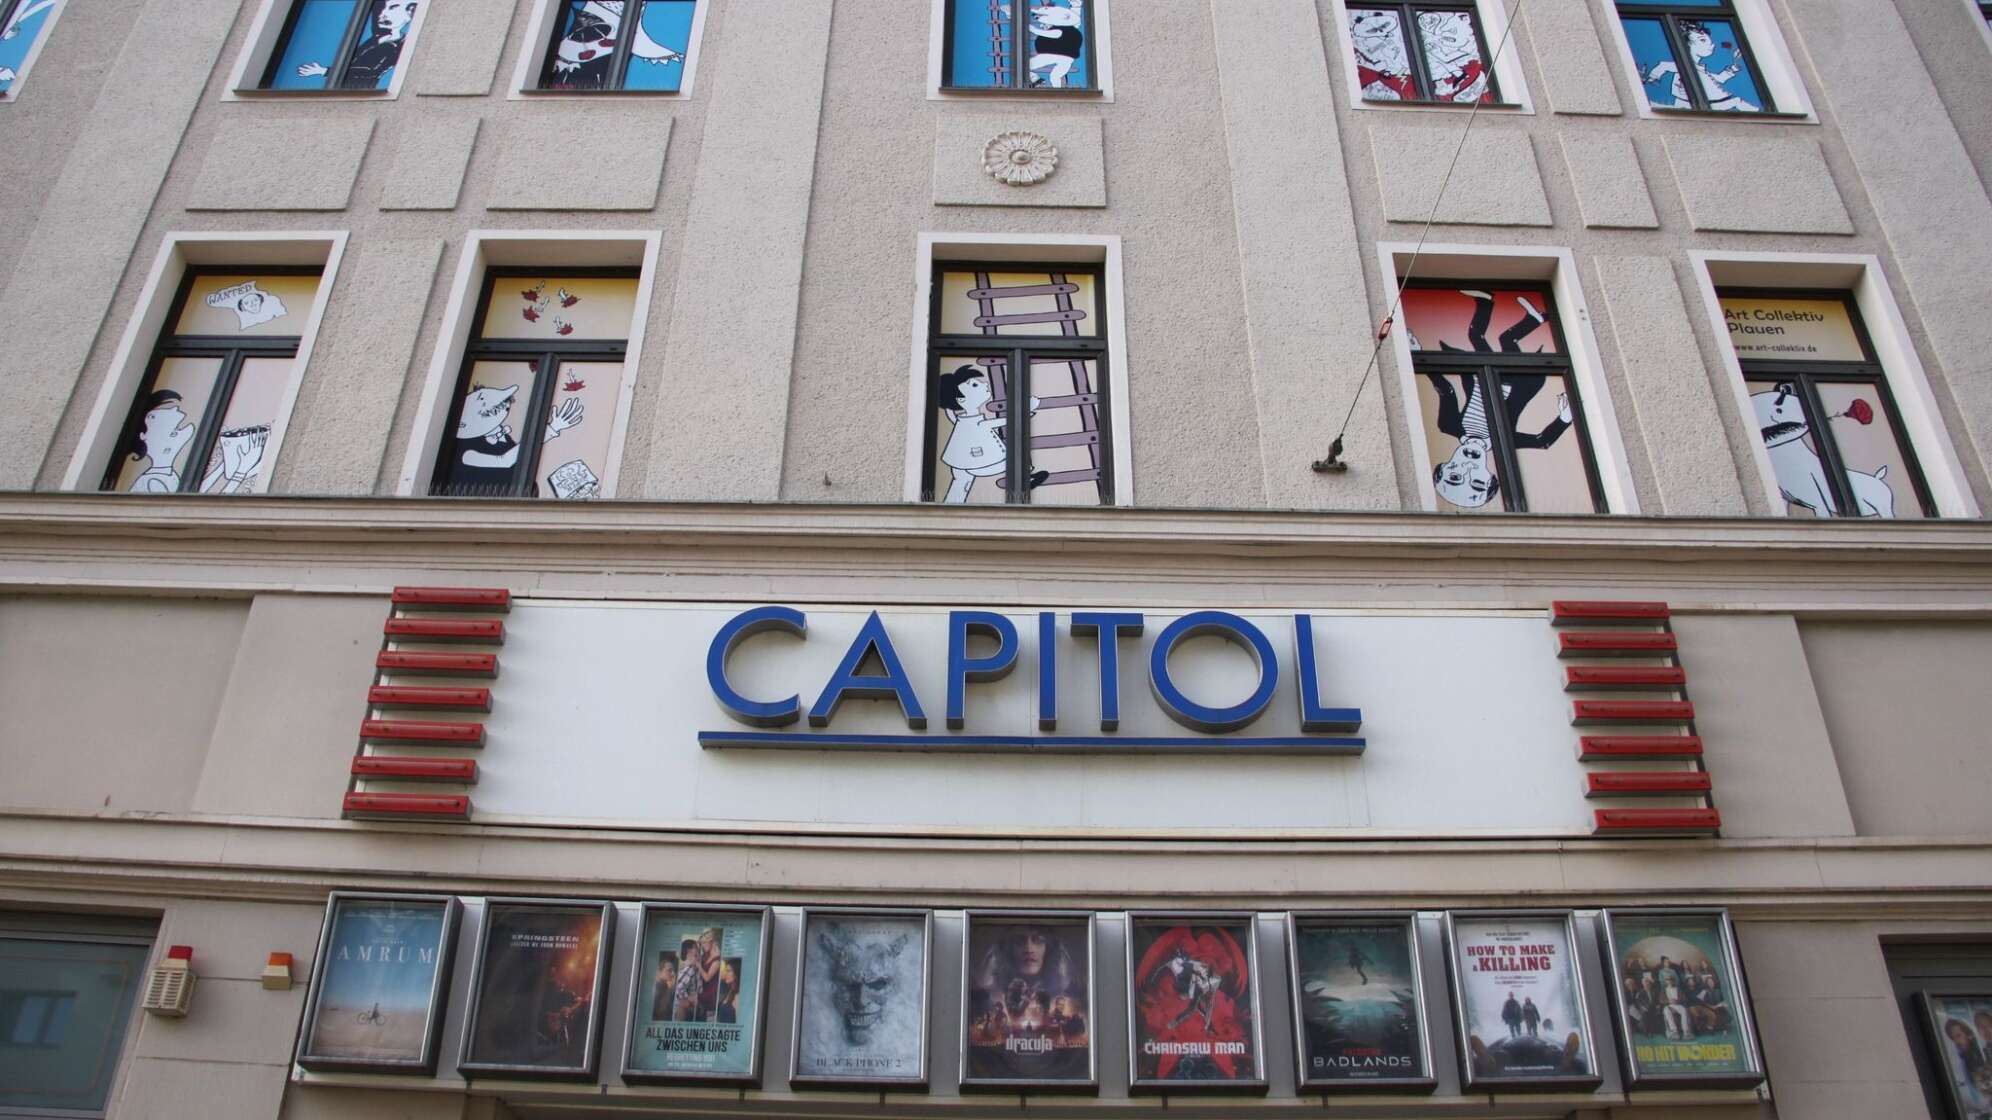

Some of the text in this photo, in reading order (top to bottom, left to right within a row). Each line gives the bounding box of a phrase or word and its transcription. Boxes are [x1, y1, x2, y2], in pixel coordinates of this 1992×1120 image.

[208, 284, 252, 304] WANTED
[1725, 309, 1824, 322] Art Collektiv
[1728, 323, 1785, 335] Plauen
[1734, 344, 1817, 352] www.art-collektiv.de
[706, 605, 1362, 734] CAPITOL
[511, 934, 580, 942] SPRINGSTEEN
[337, 944, 433, 963] AMRUM
[1466, 944, 1555, 956] HOW TO MAKE
[1478, 956, 1551, 972] KILLING
[646, 1027, 741, 1041] ALL DAS UNGESAGTE
[656, 1040, 728, 1053] ZWISCHEN UNS
[1144, 1040, 1245, 1054] CHAINSAW MAN
[1313, 1056, 1412, 1067] BADLANDS
